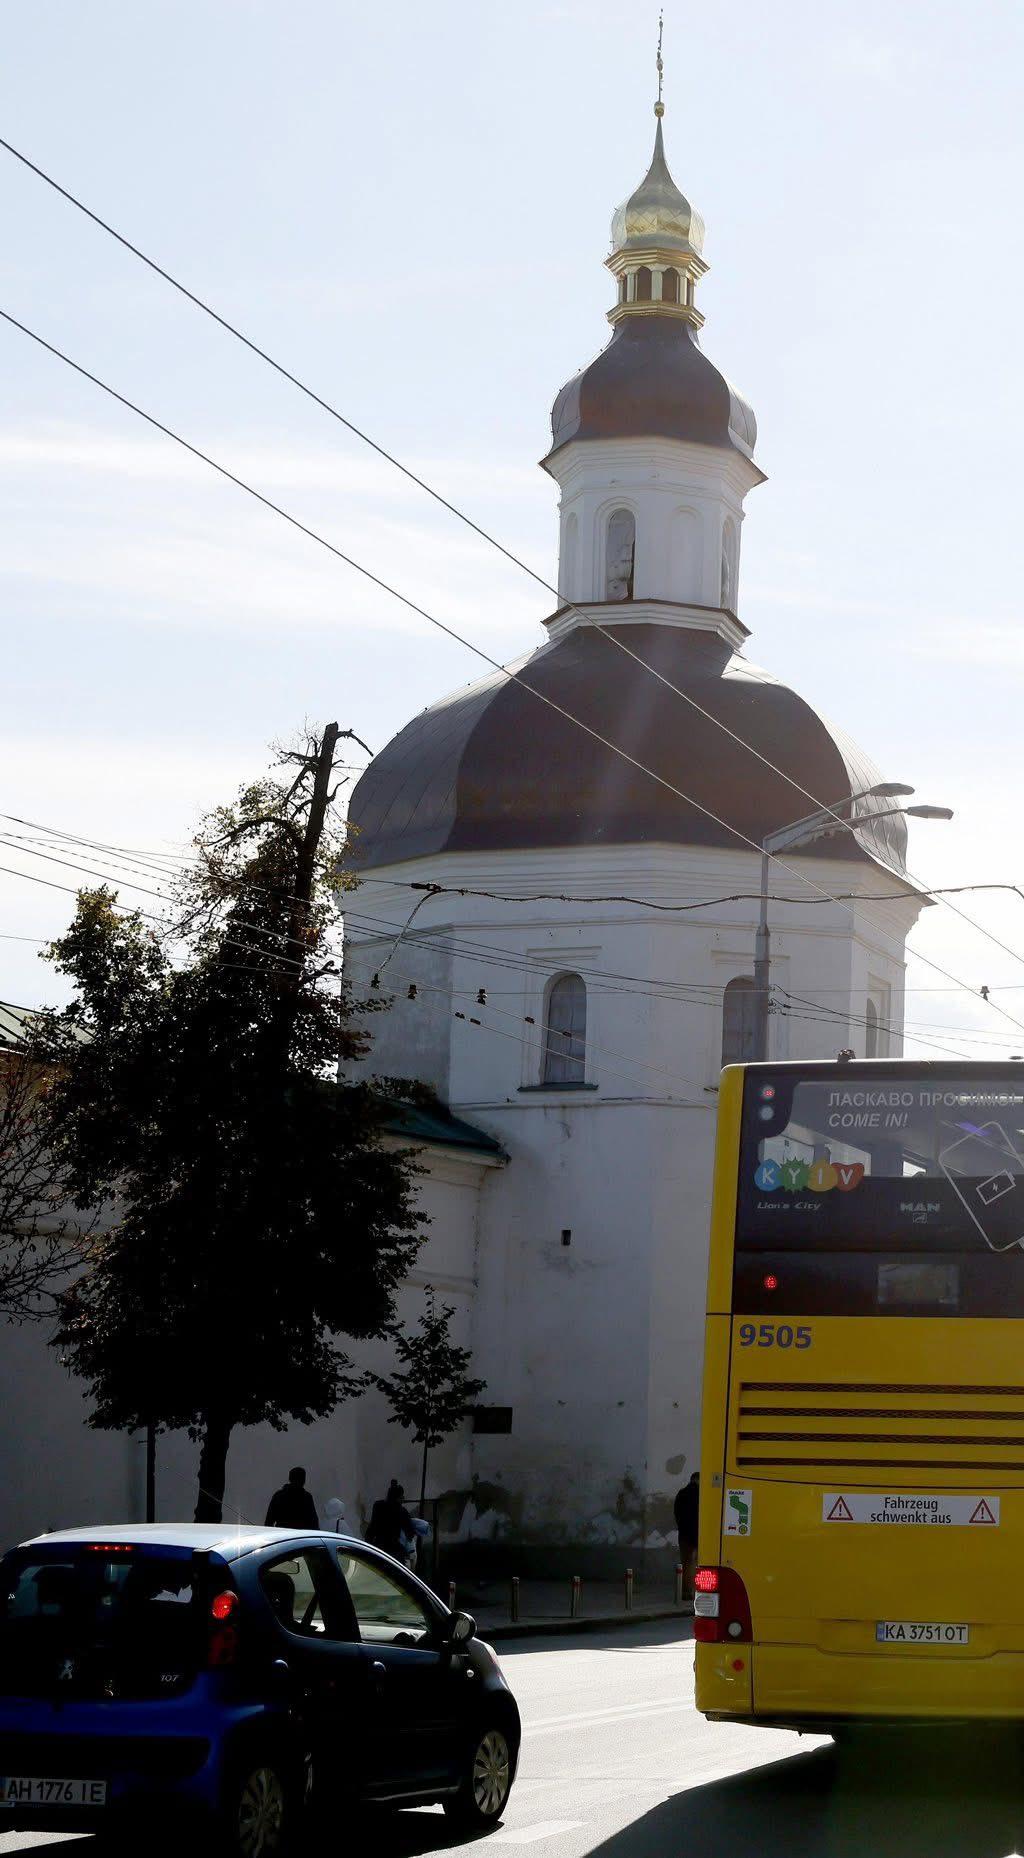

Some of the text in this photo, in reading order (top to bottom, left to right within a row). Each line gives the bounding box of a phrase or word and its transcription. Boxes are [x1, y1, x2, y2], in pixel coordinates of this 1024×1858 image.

[828, 1092, 1015, 1107] ЛАСКАВО ПРОСИМО!
[828, 1113, 908, 1127] COME IN!
[760, 1165, 856, 1187] KYIV
[757, 1202, 821, 1211] Lion's City
[900, 1202, 940, 1212] MAN
[740, 1324, 812, 1349] 9505
[884, 1496, 938, 1512] Fahrzeug
[870, 1511, 952, 1524] schwenkt aus
[885, 1624, 967, 1641] KA 3751 OT
[160, 1674, 179, 1682] 107
[7, 1780, 105, 1803] AH 1776 IE
